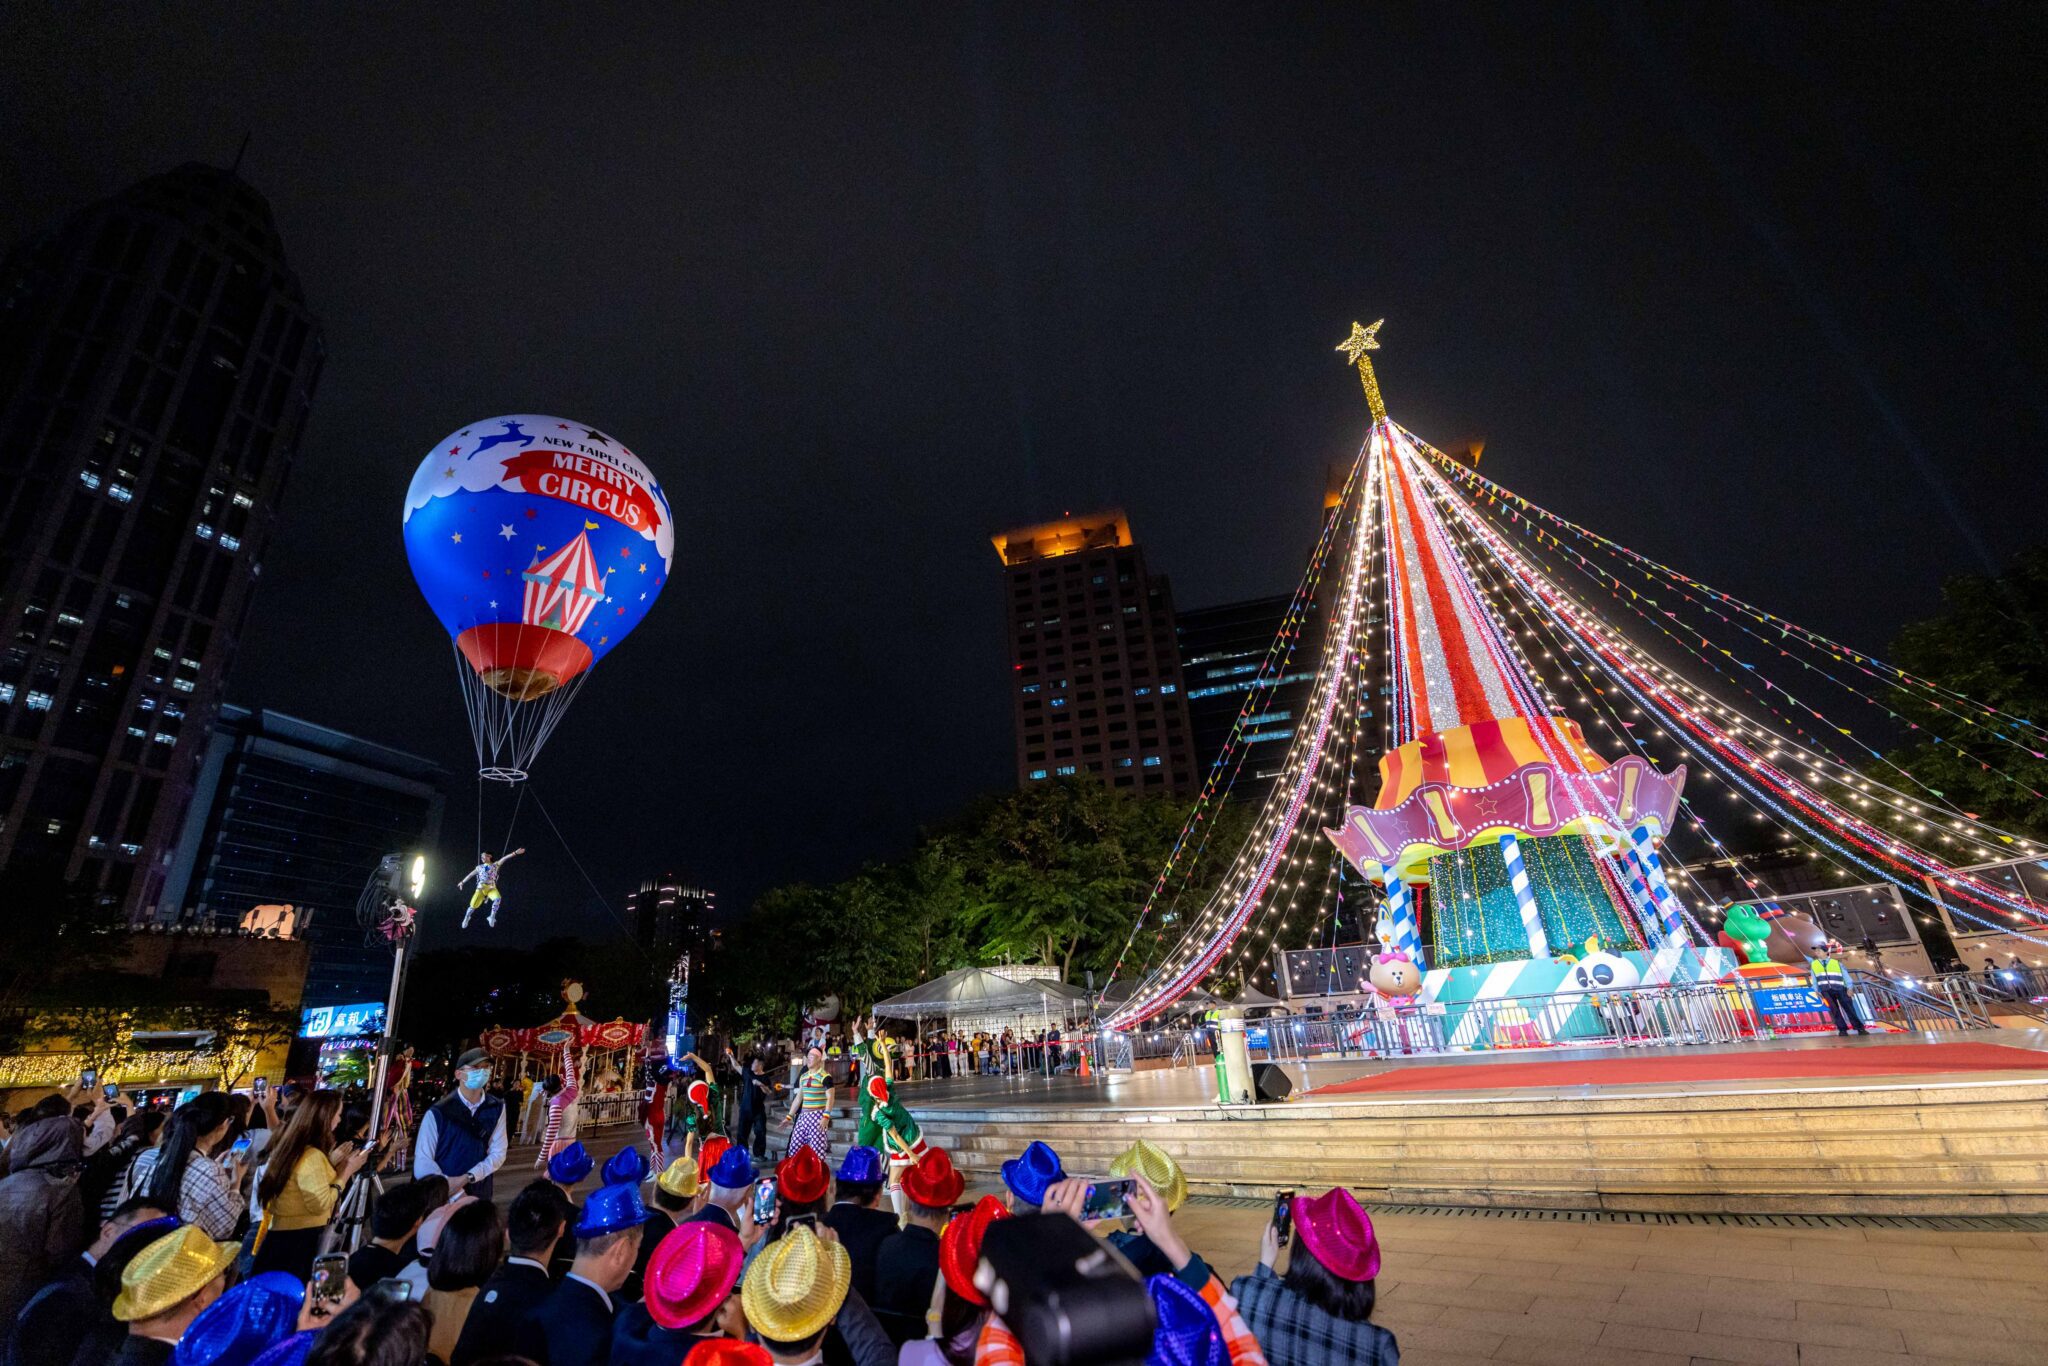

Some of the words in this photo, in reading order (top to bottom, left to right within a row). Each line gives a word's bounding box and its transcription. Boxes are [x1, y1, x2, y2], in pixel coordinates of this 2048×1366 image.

[543, 436, 574, 448] NEW
[579, 443, 619, 466] TAIPEI
[622, 463, 645, 481] CITY
[553, 453, 636, 496] MERRY
[539, 473, 640, 526] CIRCUS
